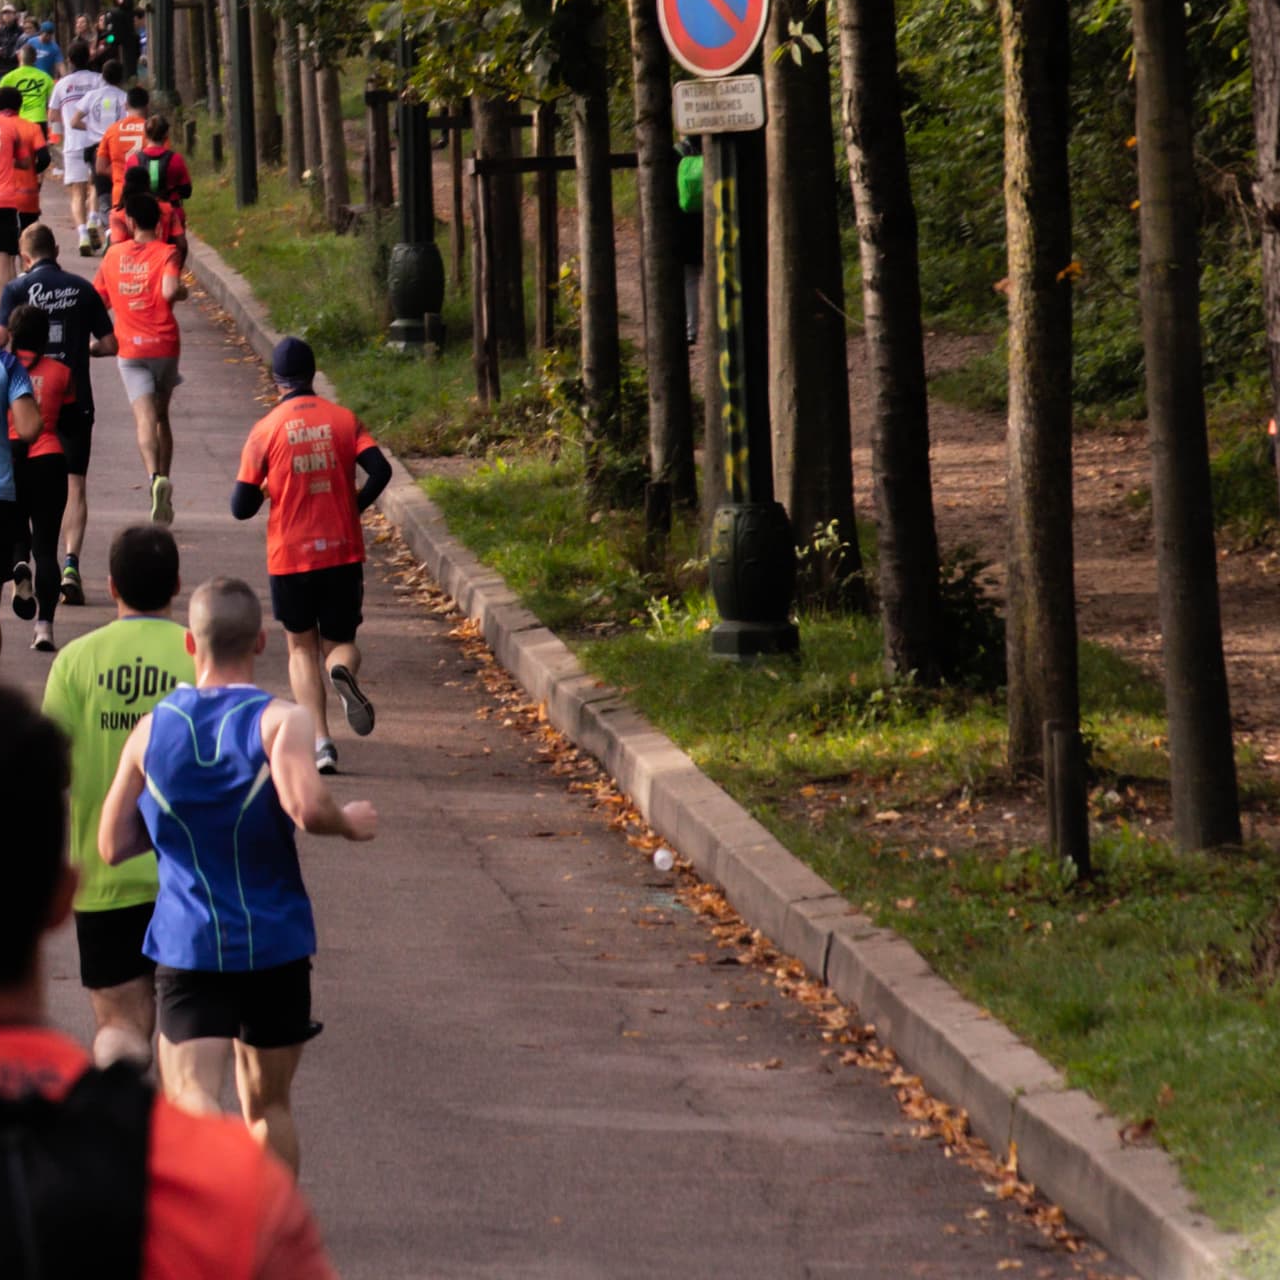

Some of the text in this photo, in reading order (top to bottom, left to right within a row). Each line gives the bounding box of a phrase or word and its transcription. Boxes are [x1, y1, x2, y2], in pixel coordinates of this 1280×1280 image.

[719, 81, 755, 95] SAMEDIS
[695, 99, 743, 113] DIMANCHES
[28, 281, 80, 308] Run Better
[40, 297, 79, 314] Together
[284, 418, 305, 431] LET'S
[287, 423, 333, 446] DANCE
[311, 440, 331, 453] LET'S
[293, 452, 329, 475] RUN
